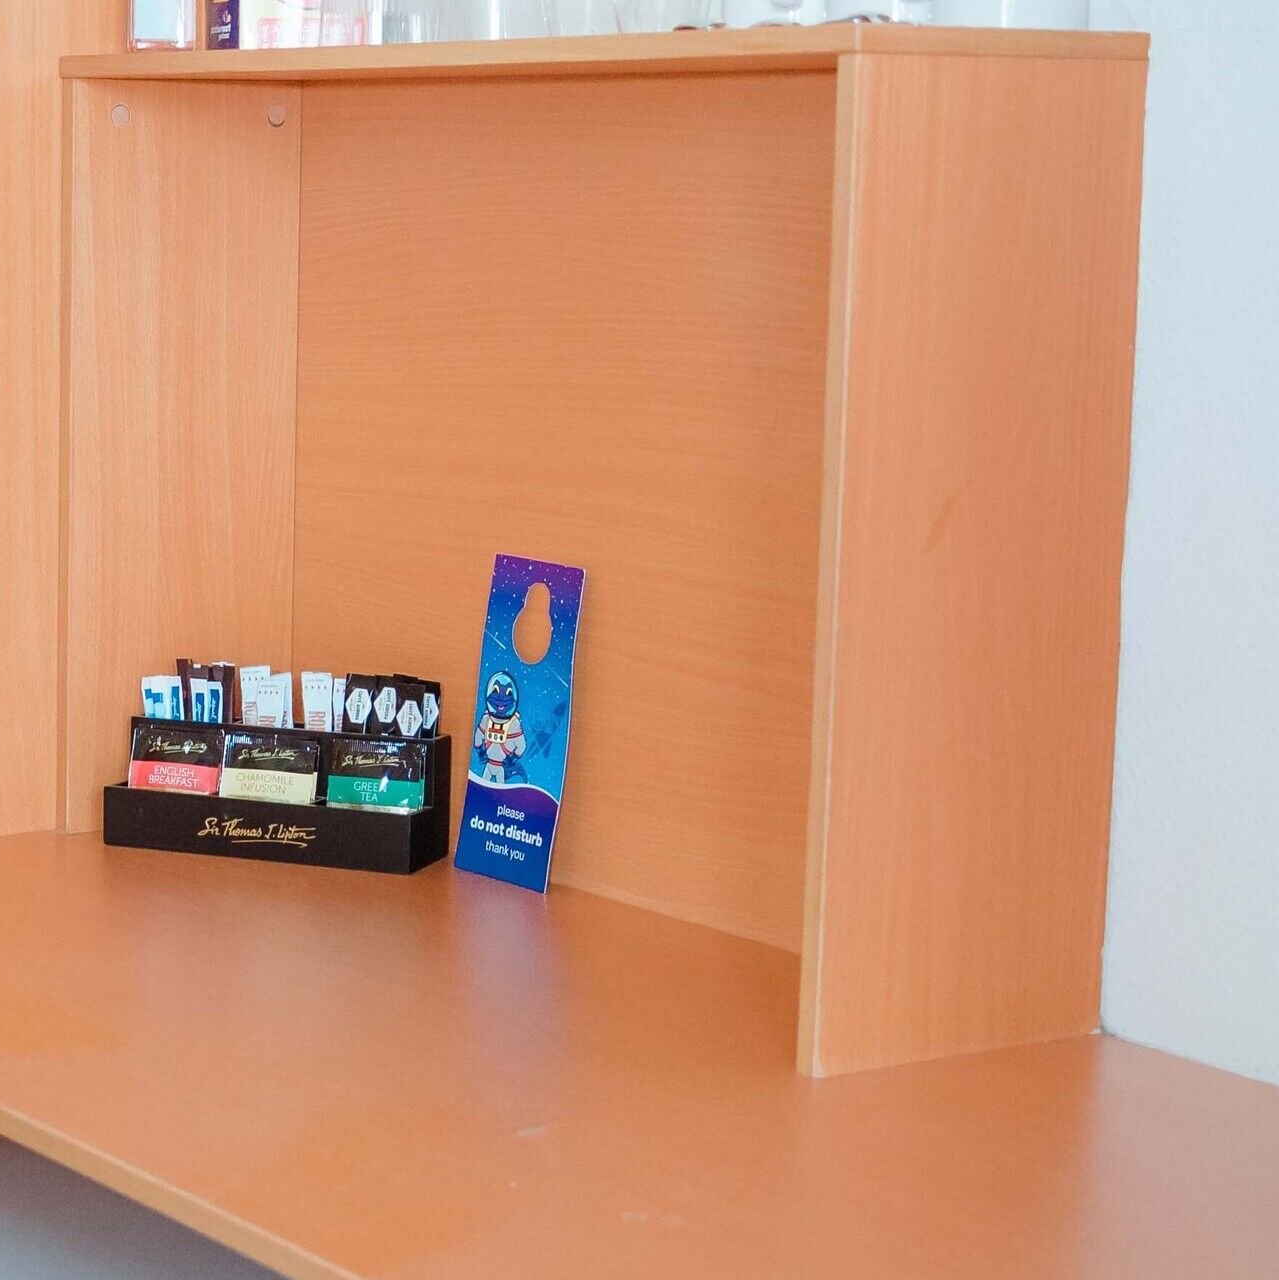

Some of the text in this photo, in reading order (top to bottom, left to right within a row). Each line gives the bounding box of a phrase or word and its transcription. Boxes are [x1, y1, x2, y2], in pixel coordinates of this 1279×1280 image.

[155, 765, 195, 778] ENGLISH
[148, 774, 200, 787] BREAKFAST
[236, 773, 294, 785] CHAMOMILE
[240, 782, 286, 793] INFUSION
[360, 792, 378, 801] TEA
[497, 804, 525, 821] please
[198, 817, 220, 836] Sir
[221, 818, 262, 838] Thomas
[277, 824, 316, 844] Lipton
[470, 815, 543, 847] do not disturb
[485, 840, 525, 861] thank you
